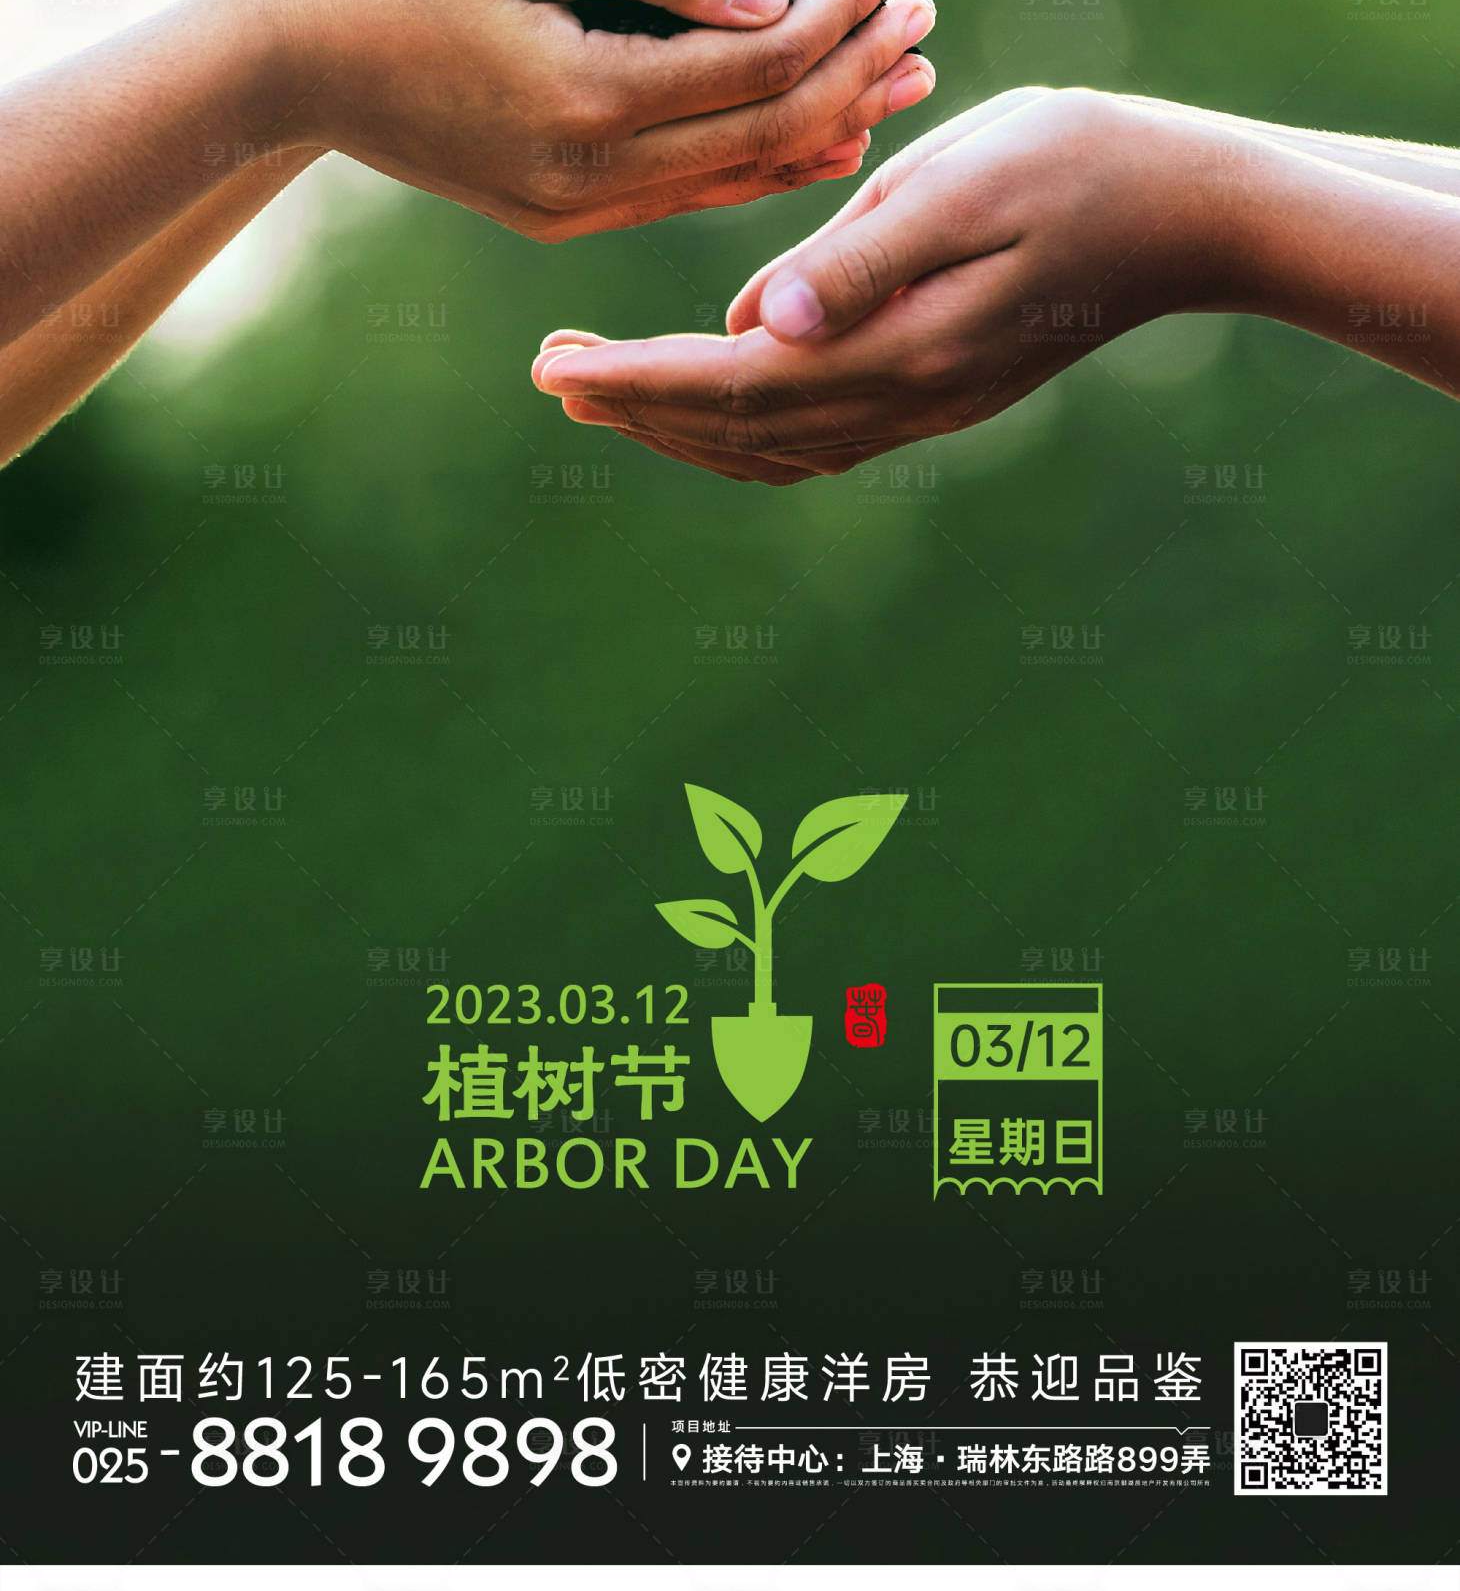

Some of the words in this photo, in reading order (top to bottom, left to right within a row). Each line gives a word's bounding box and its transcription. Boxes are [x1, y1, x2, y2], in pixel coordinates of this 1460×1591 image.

[426, 985, 689, 1024] 2023.03.12
[950, 1023, 1091, 1071] 03/12
[422, 1044, 691, 1122] 植树节
[420, 1138, 650, 1189] ARBOR
[676, 1138, 813, 1189] DAY
[949, 1117, 1093, 1166] 星期日
[971, 1351, 1202, 1403] 恭迎品鉴
[73, 1420, 148, 1438] VIP-LINE
[671, 1420, 731, 1433] 项目地址
[408, 1416, 618, 1487] 9898
